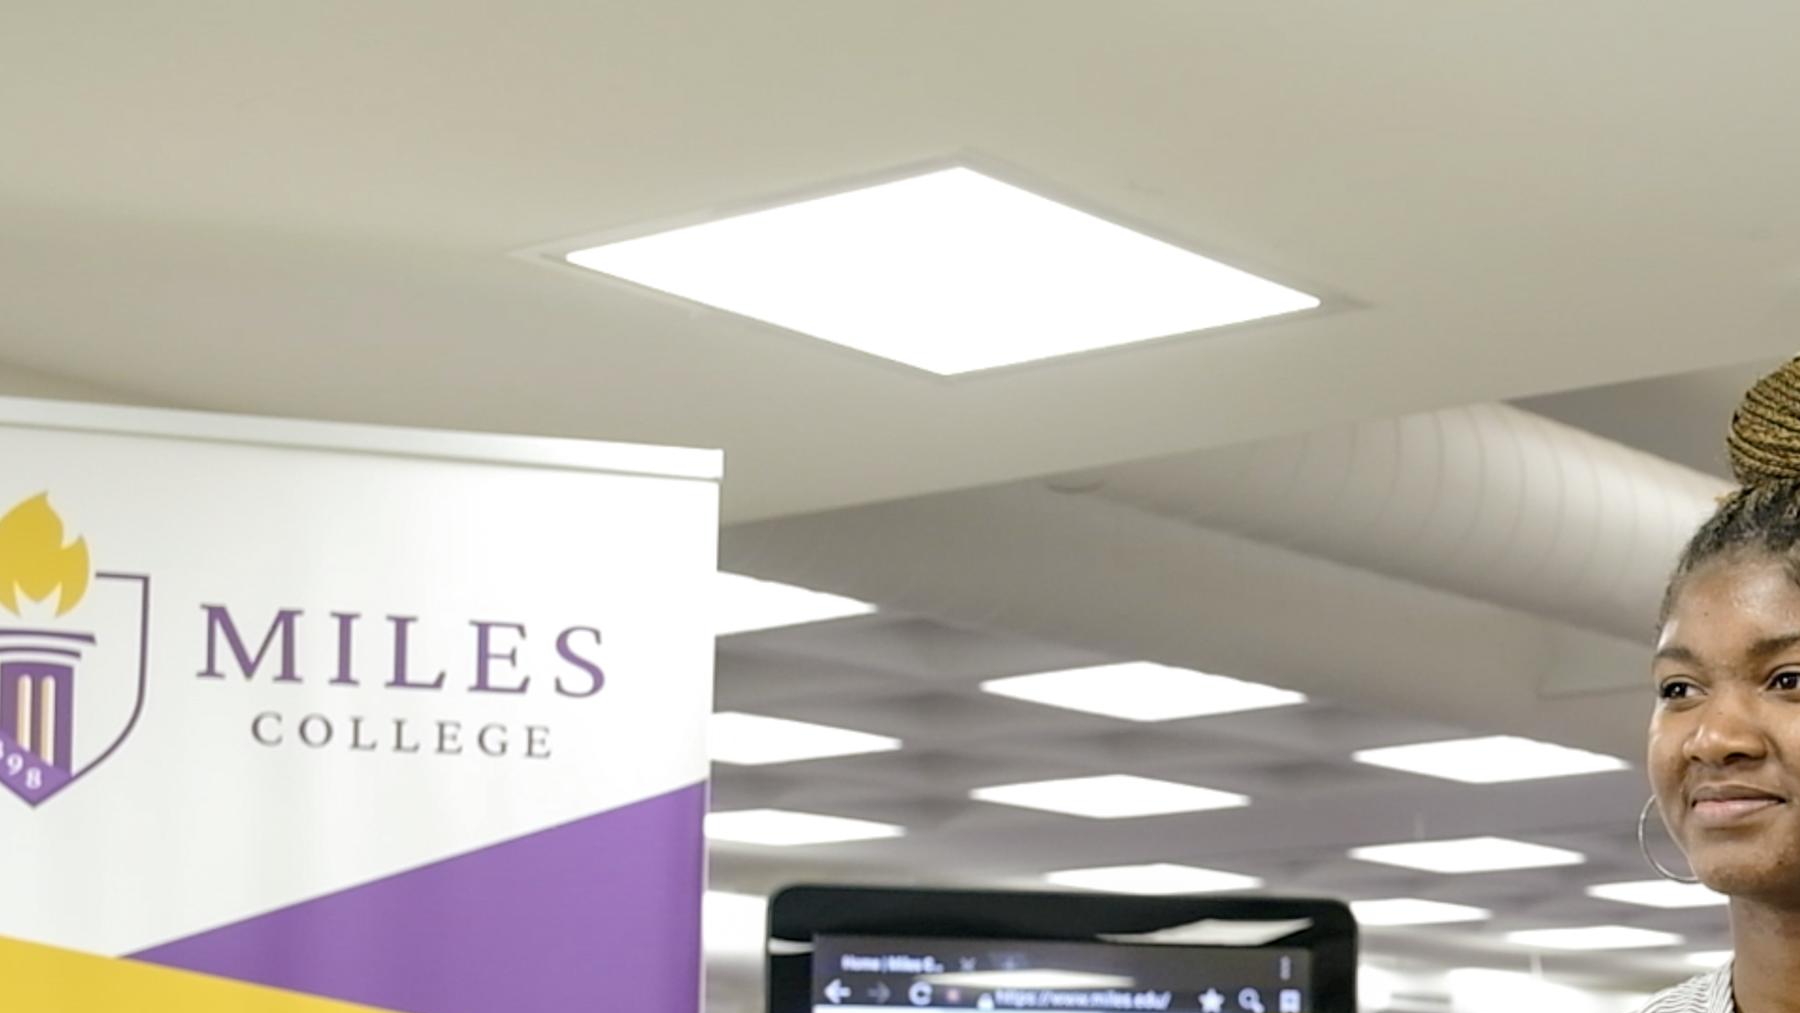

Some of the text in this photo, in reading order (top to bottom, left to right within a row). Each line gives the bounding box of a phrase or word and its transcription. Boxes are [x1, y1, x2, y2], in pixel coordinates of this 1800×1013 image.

[195, 602, 607, 699] MILES
[250, 712, 552, 759] COLLEGE
[0, 740, 43, 790] 98
